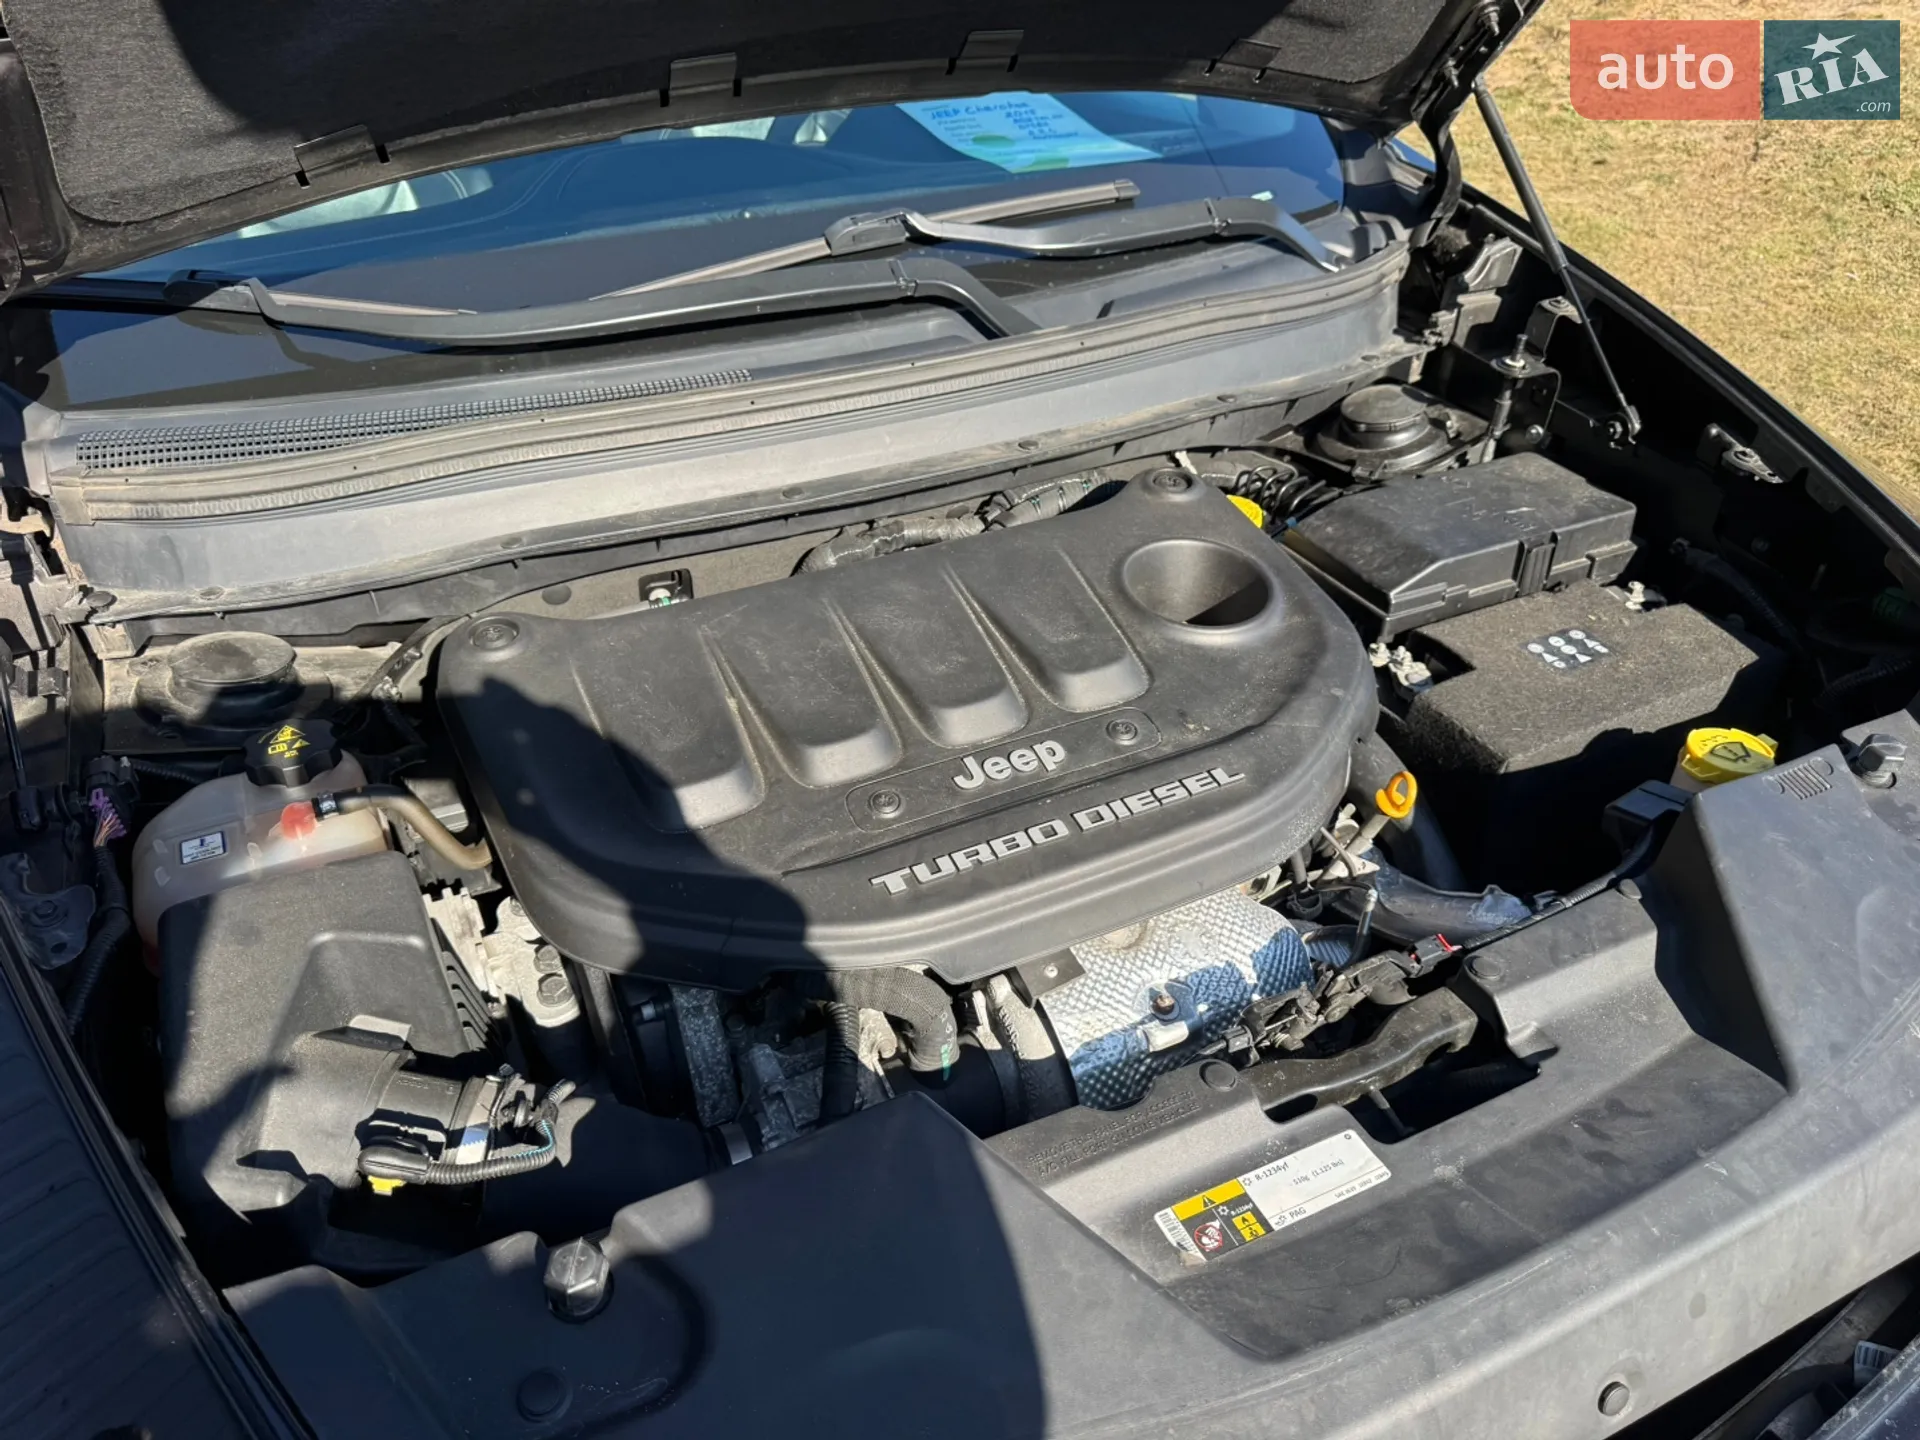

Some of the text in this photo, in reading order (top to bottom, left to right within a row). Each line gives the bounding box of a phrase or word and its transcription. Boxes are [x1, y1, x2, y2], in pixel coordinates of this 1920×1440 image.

[953, 739, 1067, 790] Jeep
[869, 767, 1247, 895] TURBO DIESEL
[1255, 1162, 1289, 1181] R-1234yf
[1289, 1206, 1307, 1220] PAG
